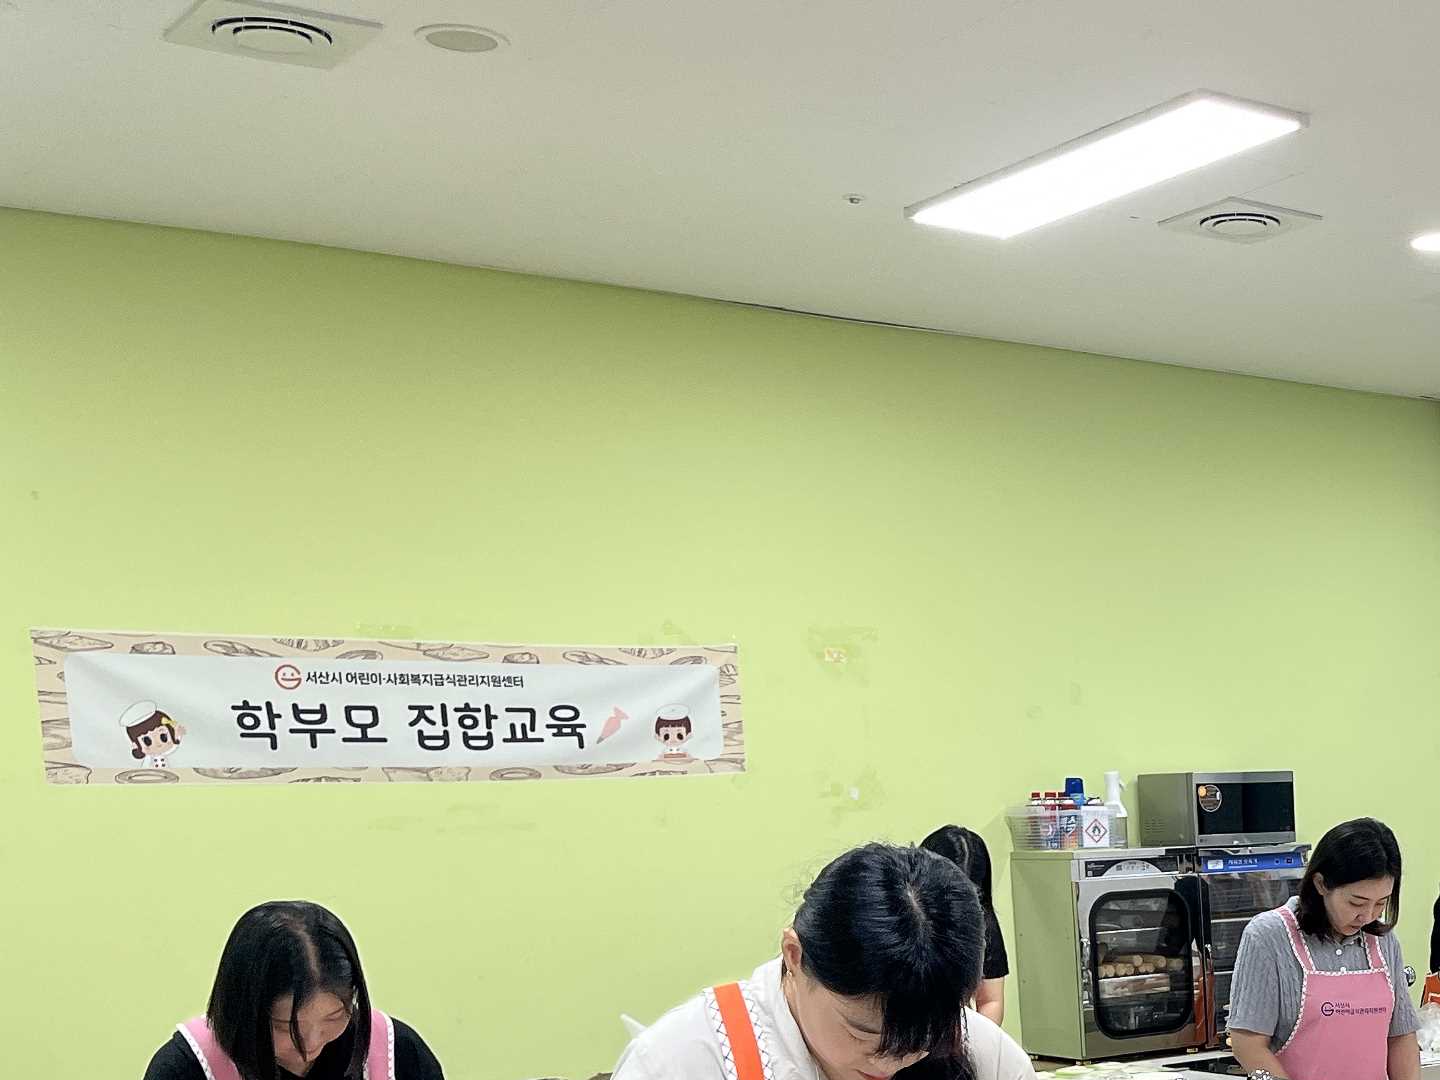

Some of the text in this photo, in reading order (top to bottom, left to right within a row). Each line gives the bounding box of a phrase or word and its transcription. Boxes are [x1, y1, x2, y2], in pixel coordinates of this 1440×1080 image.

[305, 671, 525, 689] 서산시 어린이·사회복지급식관리지원센터
[230, 699, 587, 751] 학부모 집합교육
